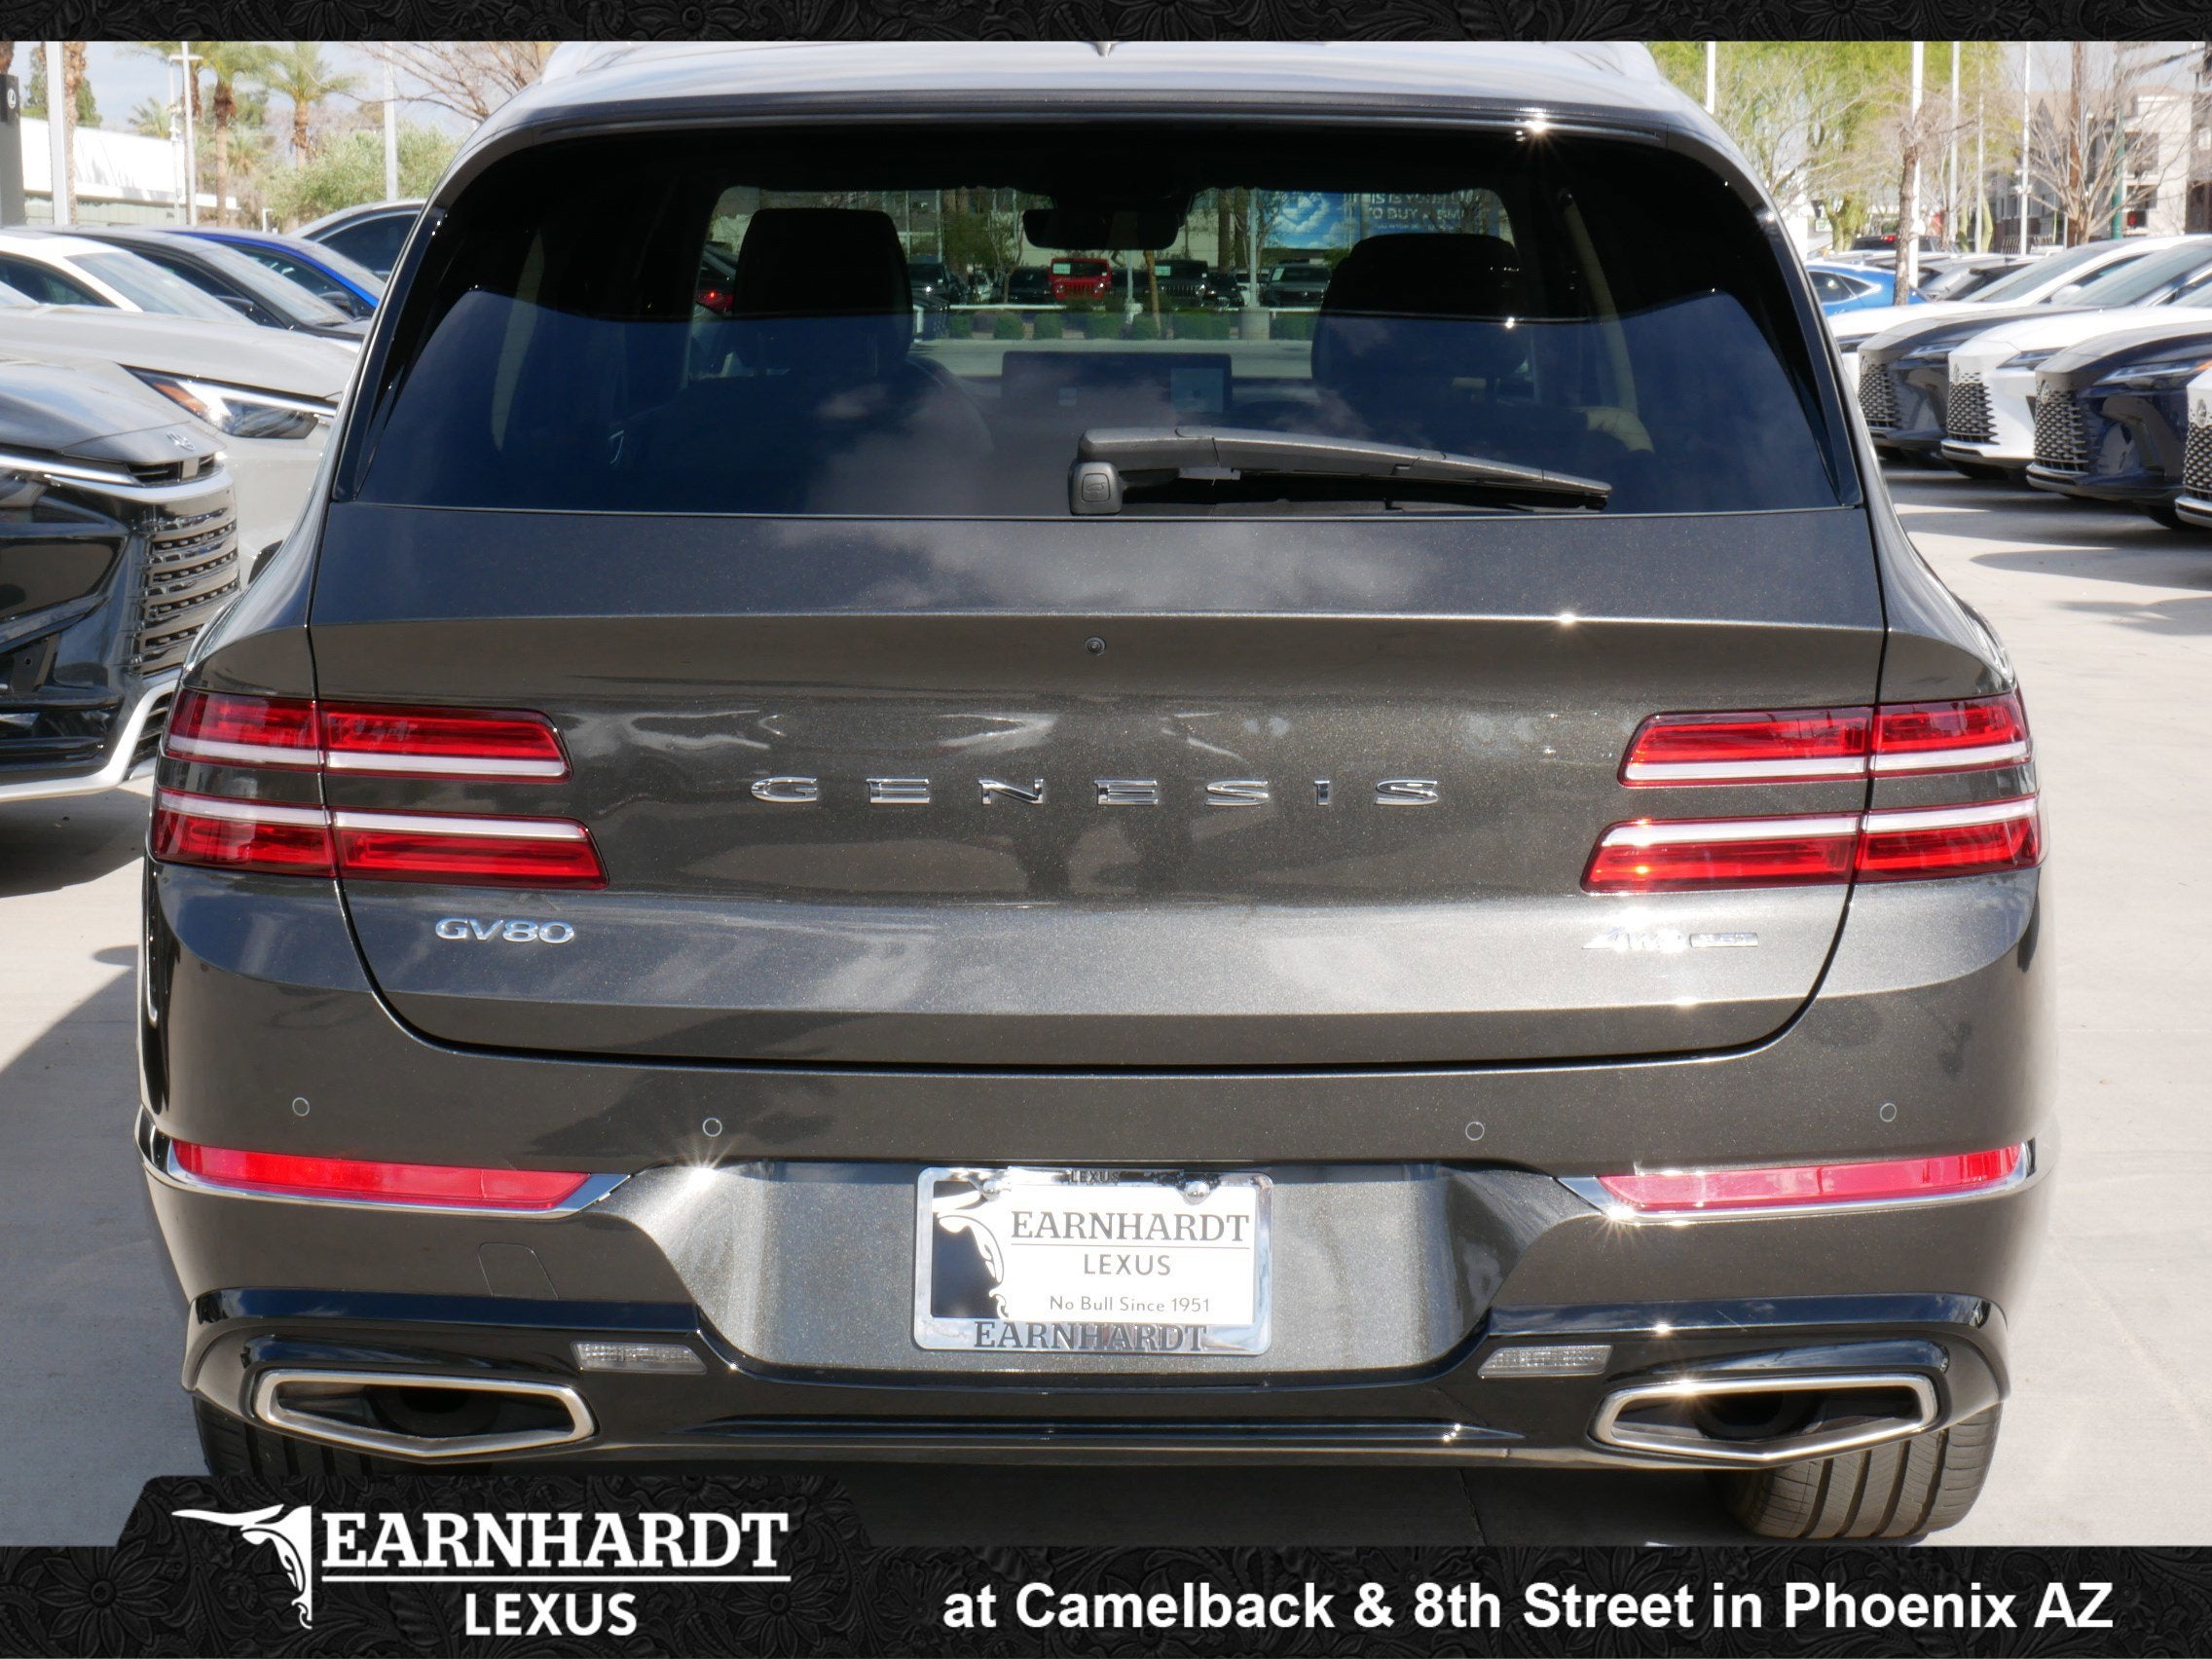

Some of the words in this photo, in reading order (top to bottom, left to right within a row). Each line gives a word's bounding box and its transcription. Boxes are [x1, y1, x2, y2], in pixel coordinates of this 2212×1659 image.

[751, 777, 1439, 806] GENESIS
[435, 917, 575, 944] GV80
[1070, 1169, 1121, 1184] LEXUS
[1011, 1210, 1250, 1242] EARNHARDT
[1083, 1254, 1171, 1276] LEXUS
[1050, 1295, 1074, 1311] No
[1081, 1296, 1114, 1311] Bull
[1119, 1296, 1165, 1312] Since
[1171, 1297, 1210, 1313] 1951
[974, 1320, 1208, 1351] EARNHARDT
